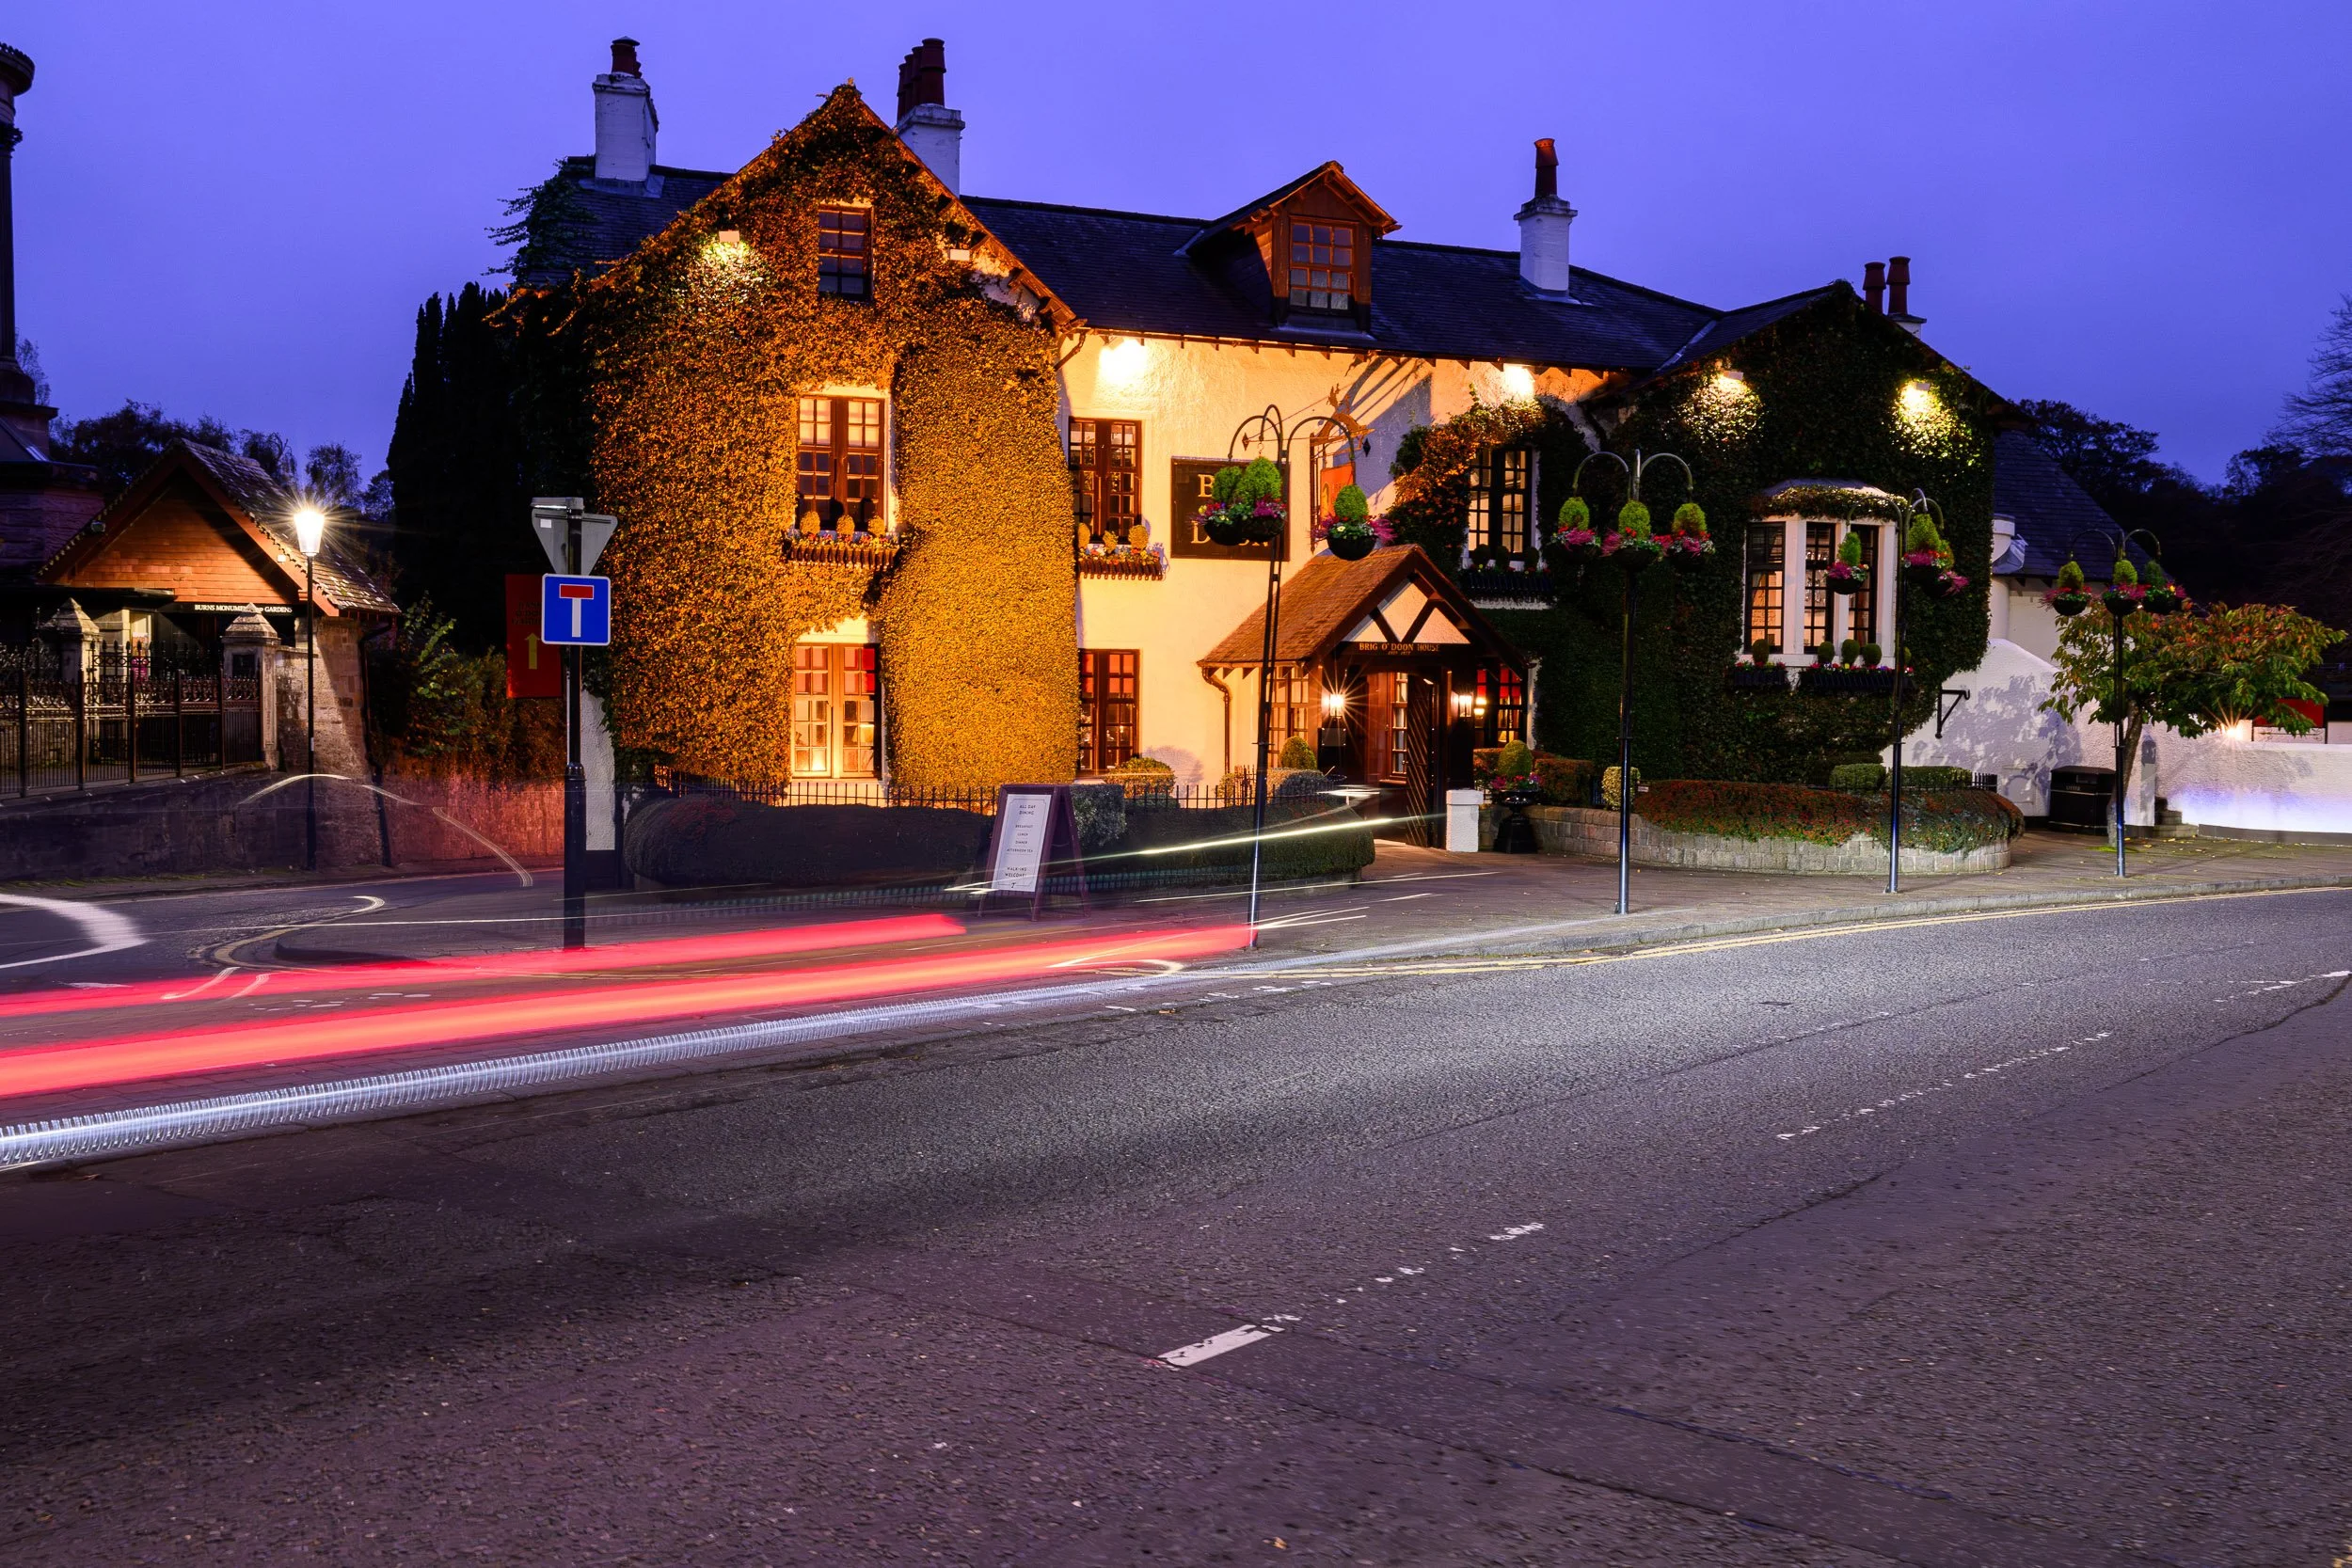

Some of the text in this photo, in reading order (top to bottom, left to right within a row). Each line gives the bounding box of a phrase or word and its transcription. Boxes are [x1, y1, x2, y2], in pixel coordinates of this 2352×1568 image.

[1359, 642, 1378, 651] BRIG
[1391, 643, 1414, 652] DOON
[1417, 643, 1440, 652] HOUSE
